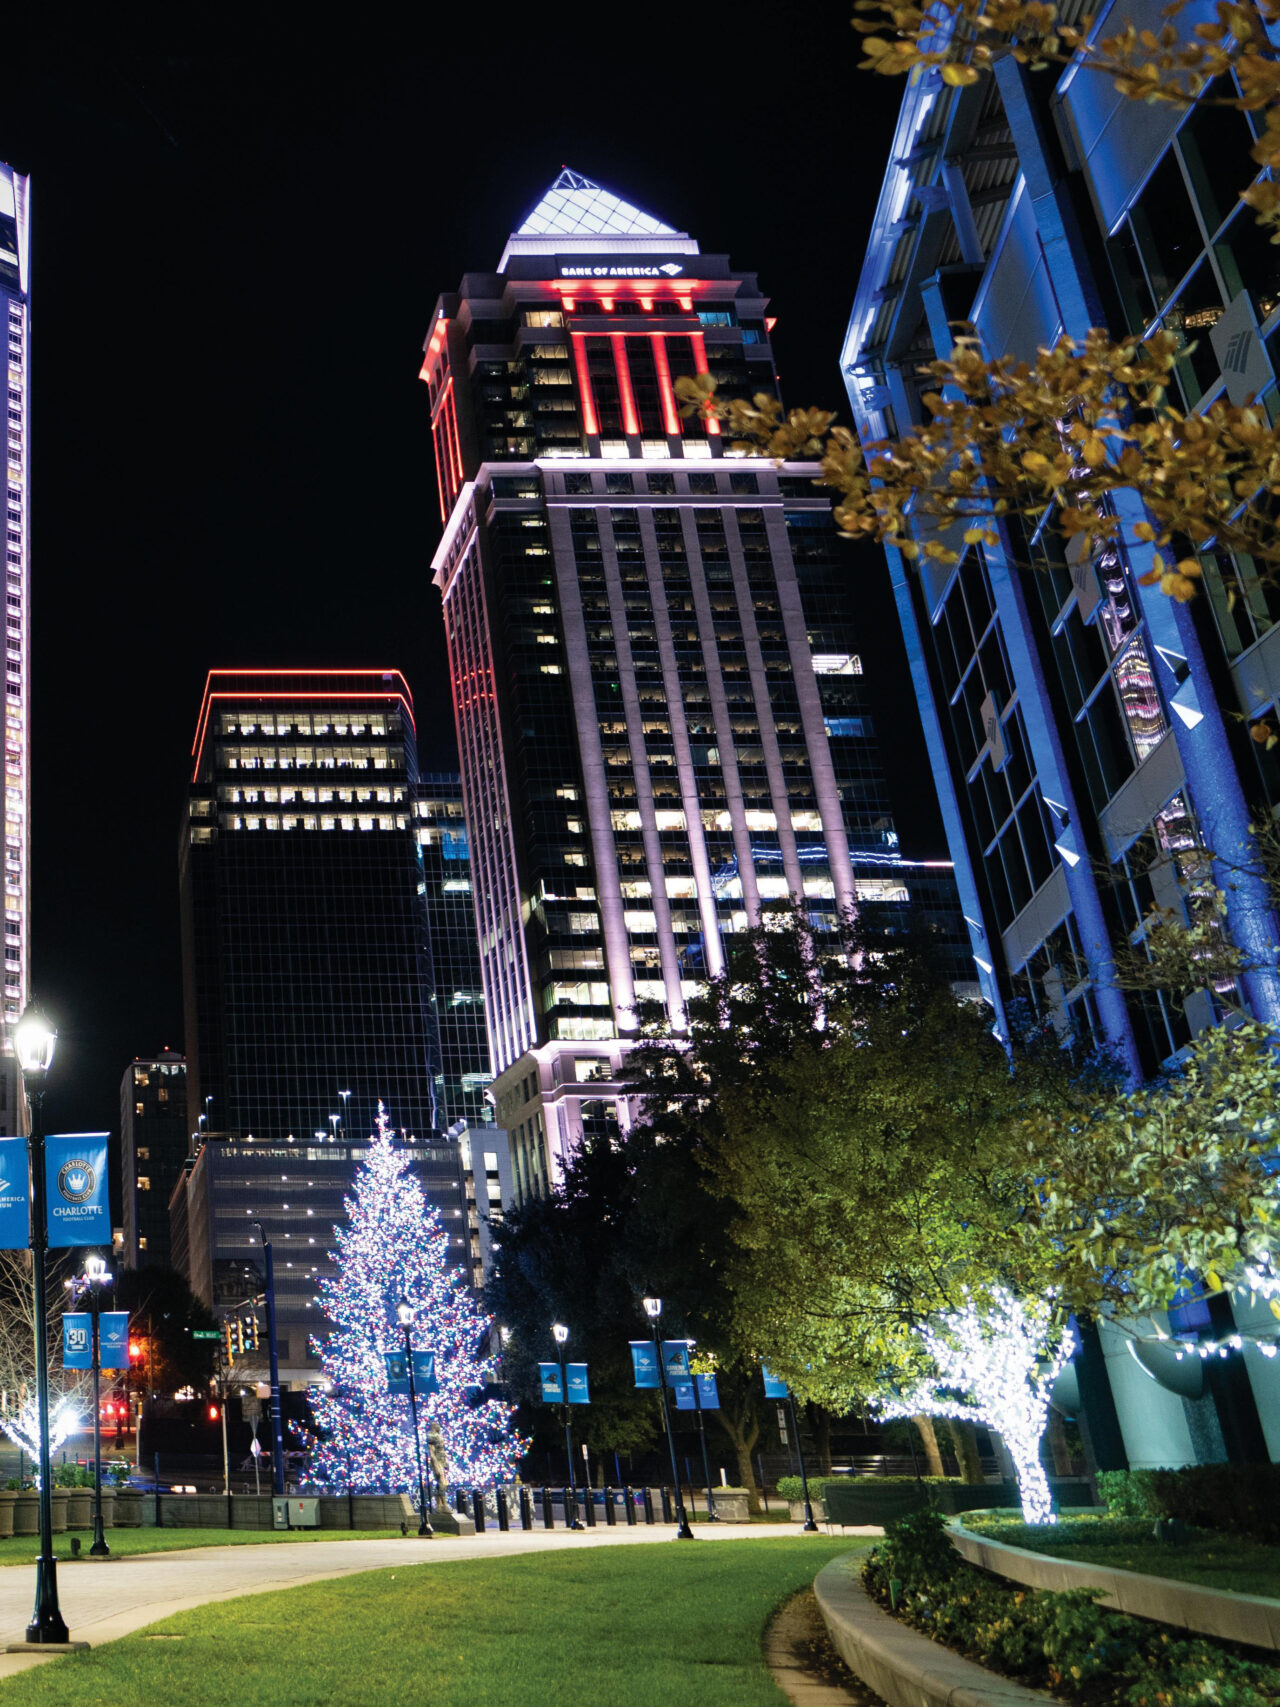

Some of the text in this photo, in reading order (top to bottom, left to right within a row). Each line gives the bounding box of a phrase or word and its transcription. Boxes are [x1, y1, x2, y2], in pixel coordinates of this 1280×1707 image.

[561, 267, 659, 276] BANK OF AMERICA
[61, 1161, 92, 1175] CHARLOTTE
[53, 1205, 103, 1217] CHARLOTTE
[69, 1329, 86, 1345] 30
